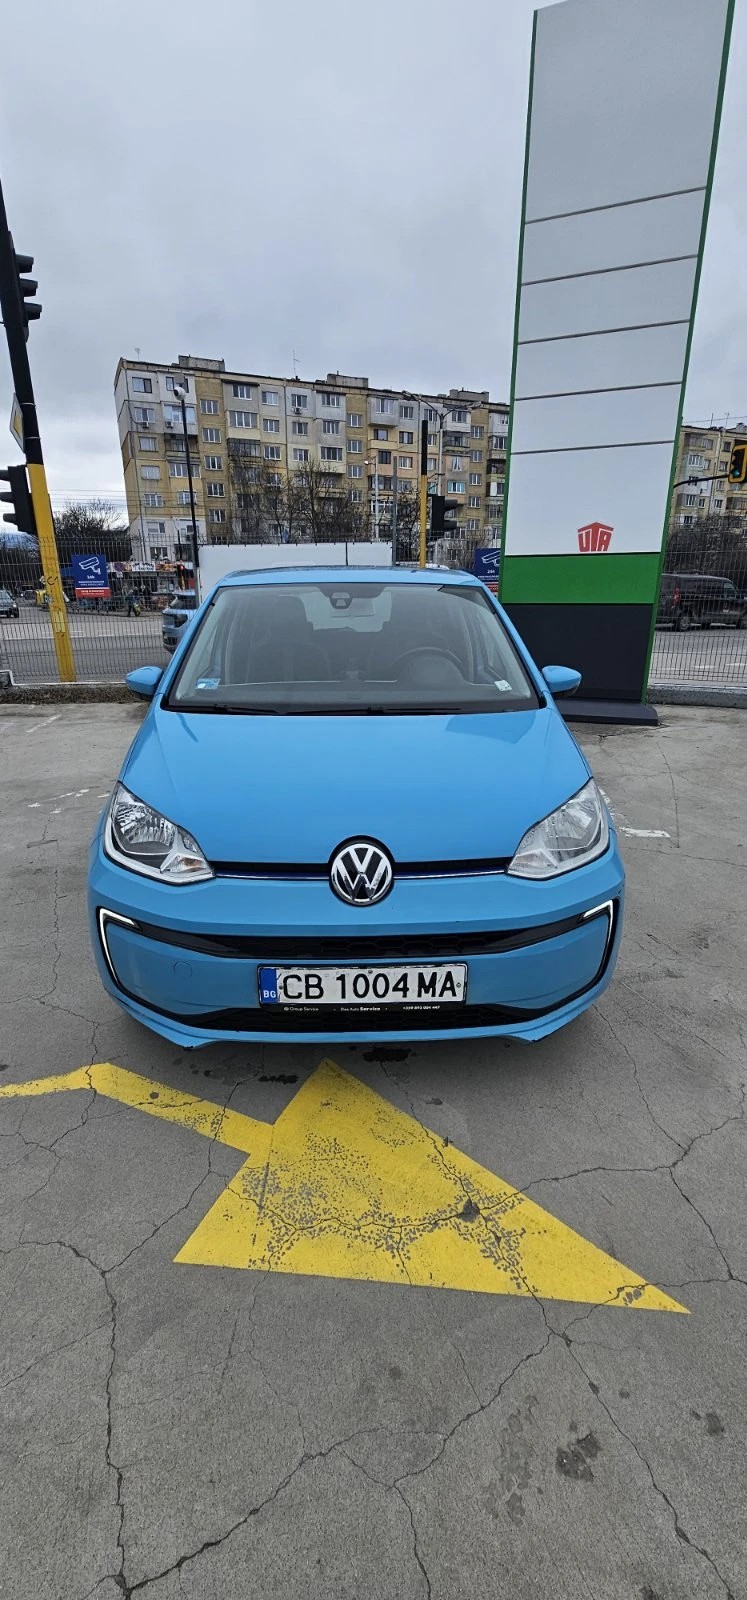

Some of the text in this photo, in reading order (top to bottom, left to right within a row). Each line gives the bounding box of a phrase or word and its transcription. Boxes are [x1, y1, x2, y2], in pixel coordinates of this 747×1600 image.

[577, 521, 614, 552] UTA
[263, 990, 276, 998] BG
[283, 970, 457, 999] CB 1004 MA
